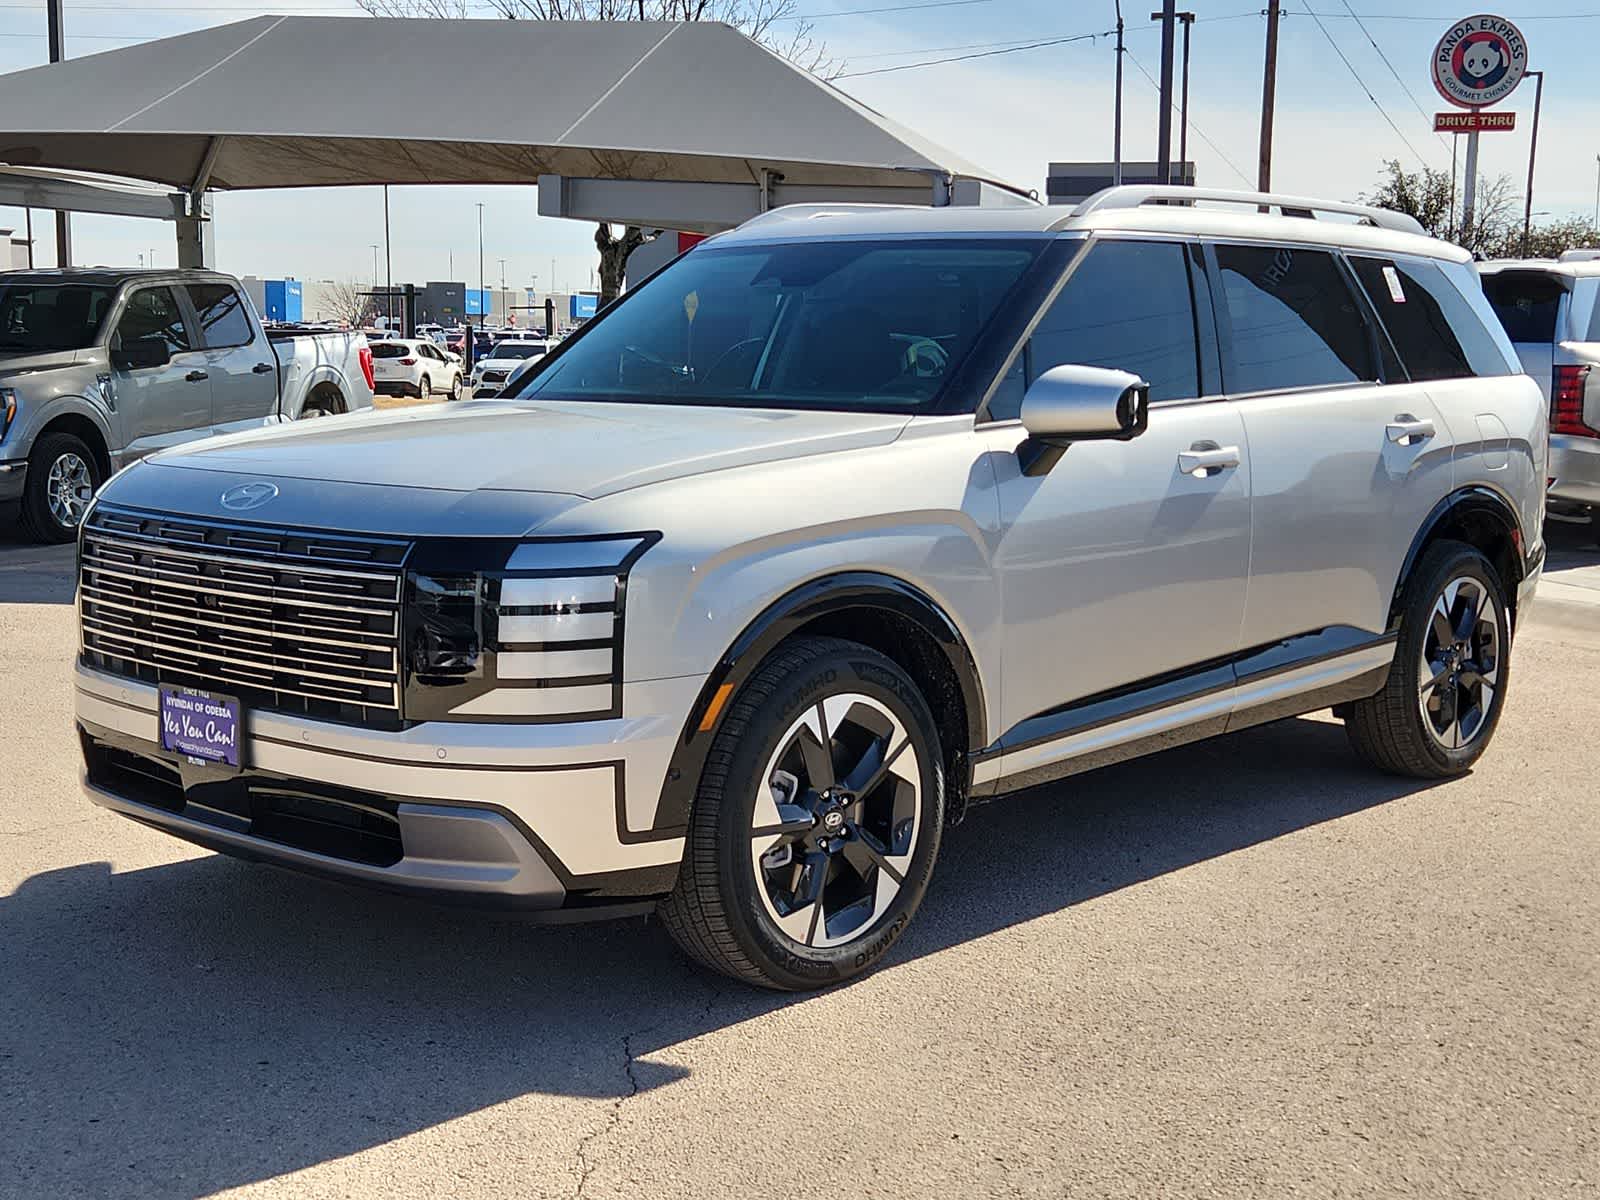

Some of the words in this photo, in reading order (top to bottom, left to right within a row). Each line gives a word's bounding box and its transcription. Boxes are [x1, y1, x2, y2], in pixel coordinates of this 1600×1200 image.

[1439, 22, 1475, 63] PANDA
[1480, 19, 1524, 60] EXPRESS
[1444, 76, 1481, 100] GOURMET
[1484, 76, 1516, 99] CHINESE
[1437, 116, 1476, 126] DRIVE
[1480, 116, 1515, 126] THRU
[195, 703, 205, 712] OF
[205, 704, 232, 719] ODESSA
[163, 710, 180, 735] Yes
[182, 714, 203, 738] You
[205, 720, 235, 747] Can!
[854, 912, 908, 969] KUMHO
